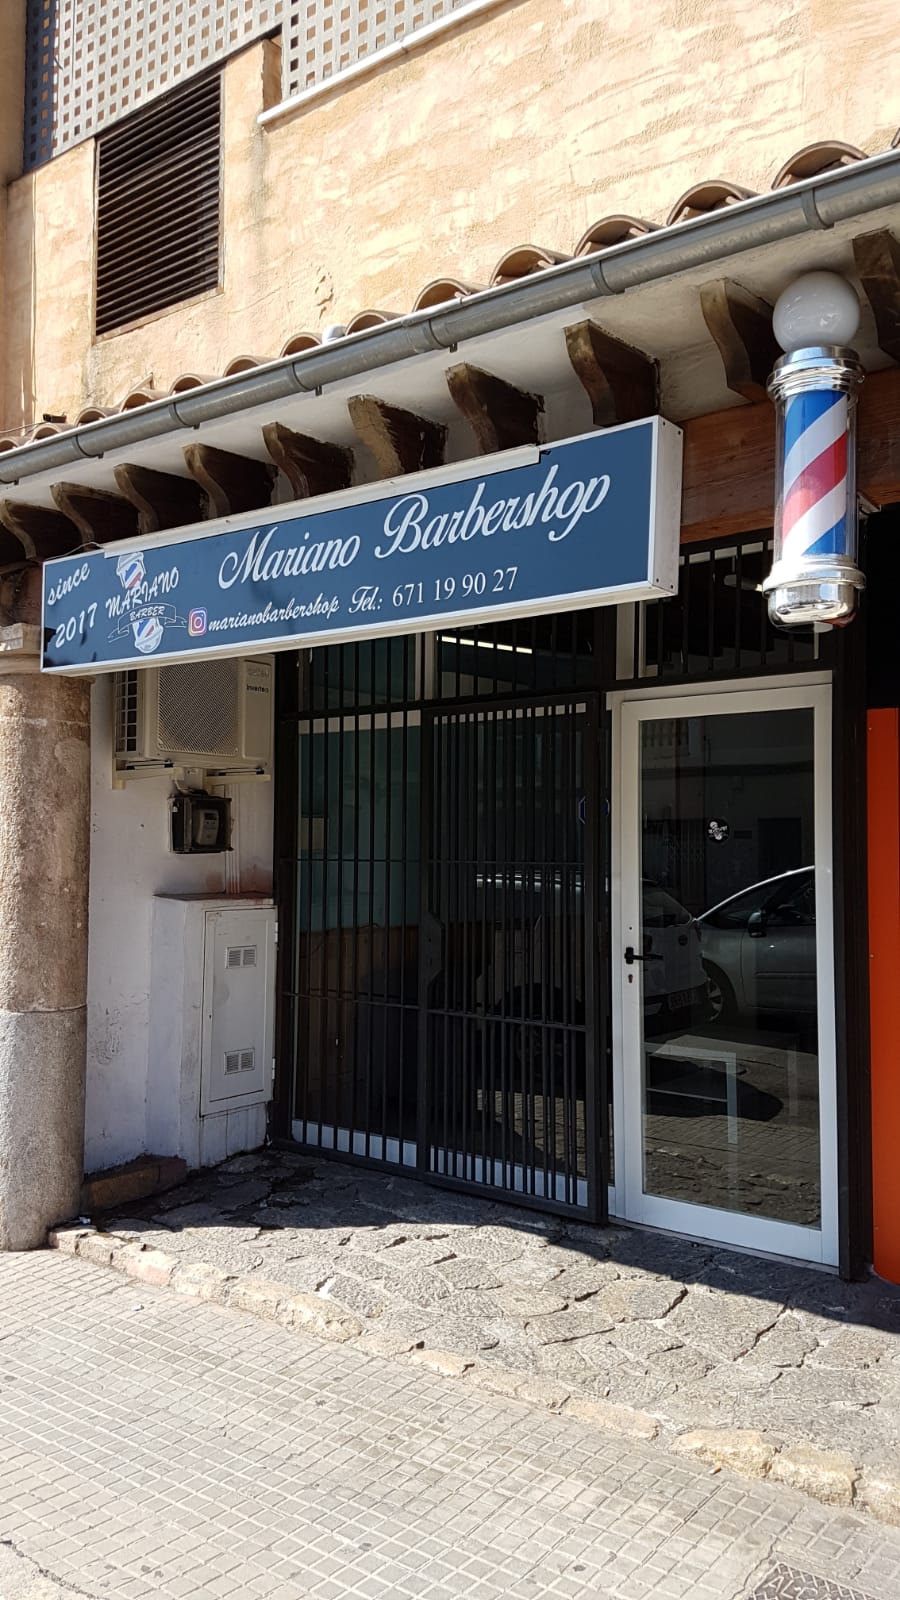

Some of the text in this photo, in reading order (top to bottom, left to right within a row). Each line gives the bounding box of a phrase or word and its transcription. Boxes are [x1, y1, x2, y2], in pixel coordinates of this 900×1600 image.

[218, 464, 611, 589] Mariano Barbershop
[48, 562, 90, 605] since
[105, 566, 179, 618] MARIANO
[208, 566, 519, 632] marianobarbershop Tel.: 671 19 90 27
[55, 602, 98, 648] 2017
[129, 605, 166, 621] BARBER
